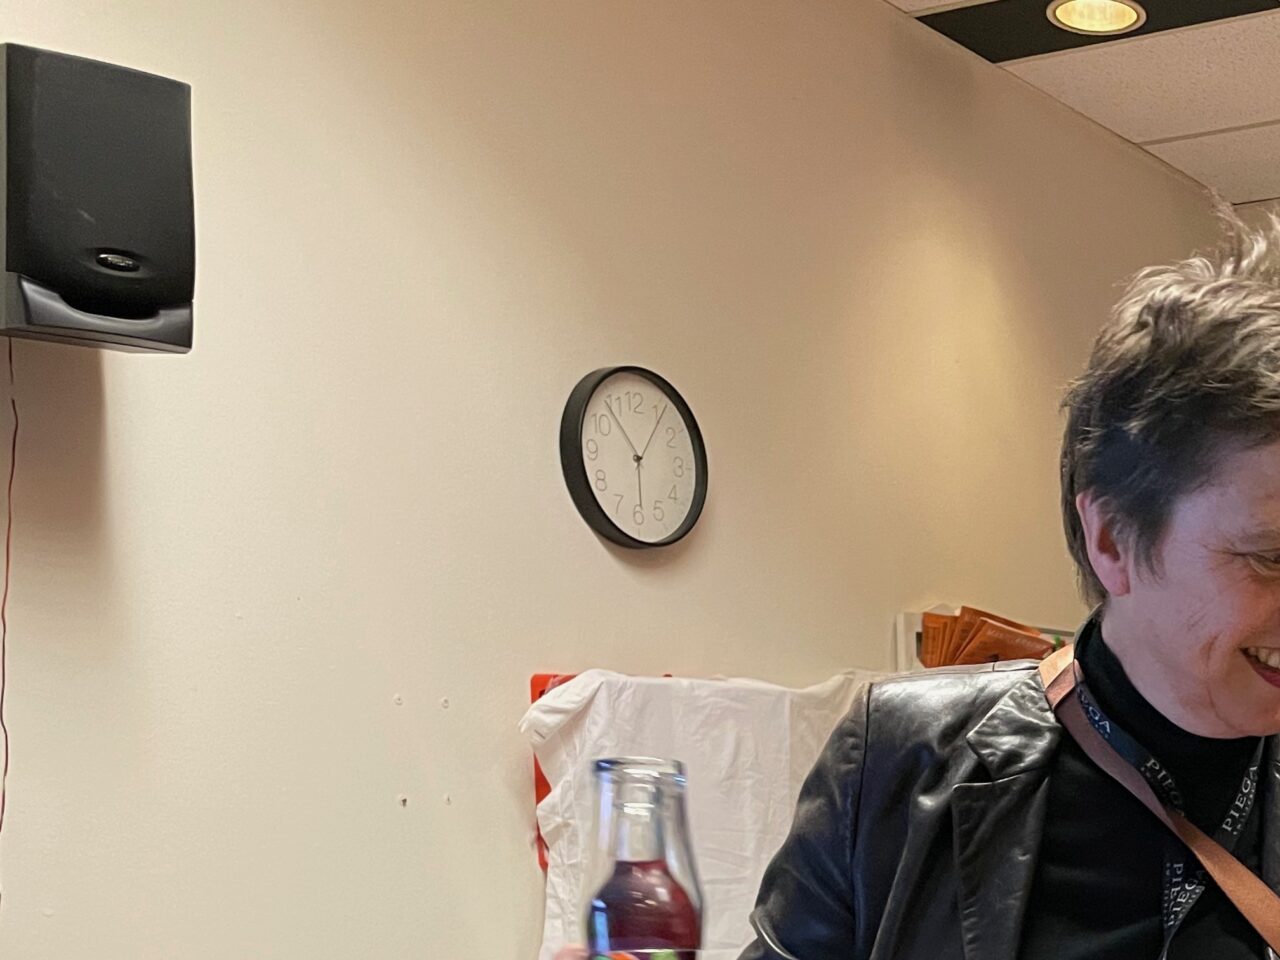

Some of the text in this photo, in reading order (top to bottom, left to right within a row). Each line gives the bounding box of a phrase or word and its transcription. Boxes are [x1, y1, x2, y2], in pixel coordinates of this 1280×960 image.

[606, 394, 623, 417] 11
[625, 391, 644, 414] 12
[592, 413, 611, 436] 10
[666, 427, 677, 448] 2
[586, 439, 598, 461] 9
[673, 456, 684, 478] 3
[595, 469, 607, 492] 8
[614, 494, 624, 515] 7
[668, 485, 677, 502] 4
[633, 504, 645, 526] 6
[653, 500, 664, 522] 5
[1221, 765, 1258, 832] PIEGA
